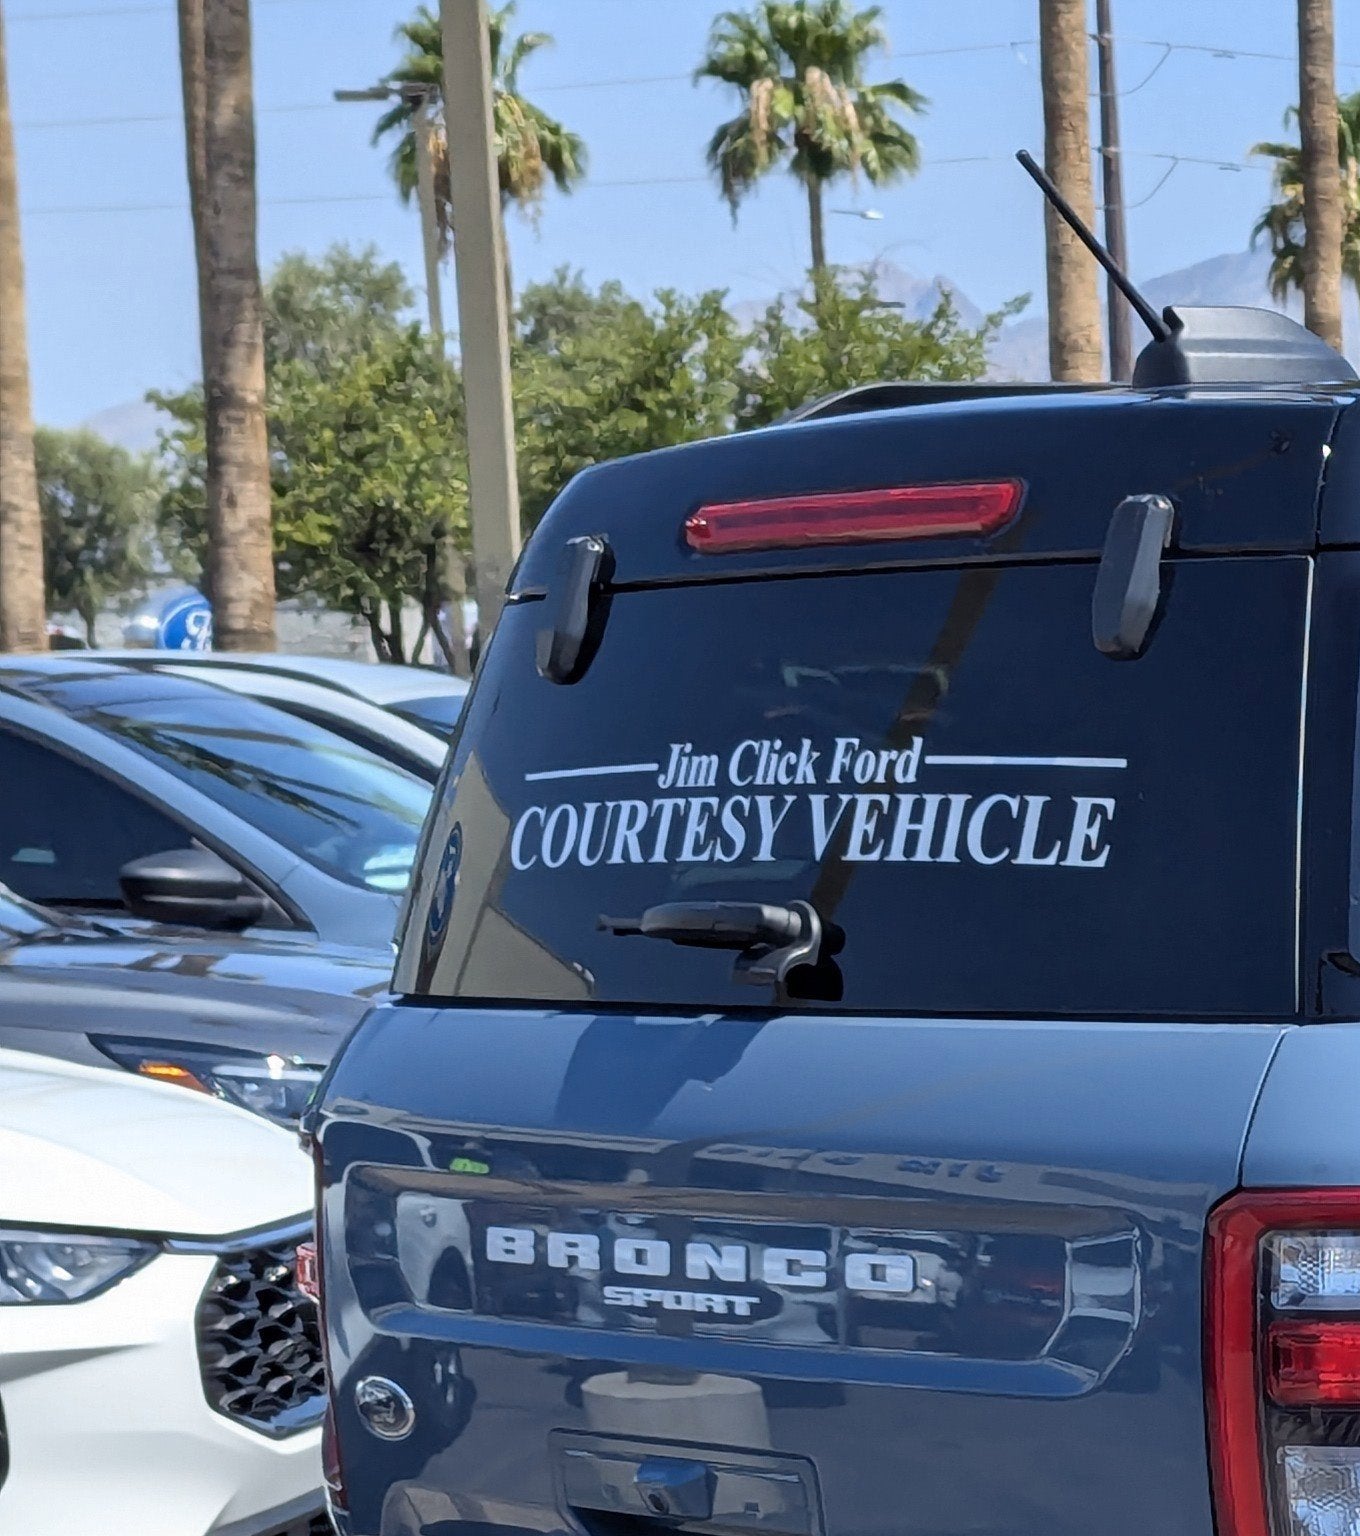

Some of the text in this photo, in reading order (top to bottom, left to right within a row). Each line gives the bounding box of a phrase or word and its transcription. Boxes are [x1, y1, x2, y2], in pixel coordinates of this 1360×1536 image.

[657, 735, 924, 789] Jim Click Ford
[510, 793, 1117, 871] COURTESY VEHICLE
[485, 1226, 915, 1294] BRONCO
[602, 1285, 761, 1317] SPORT
